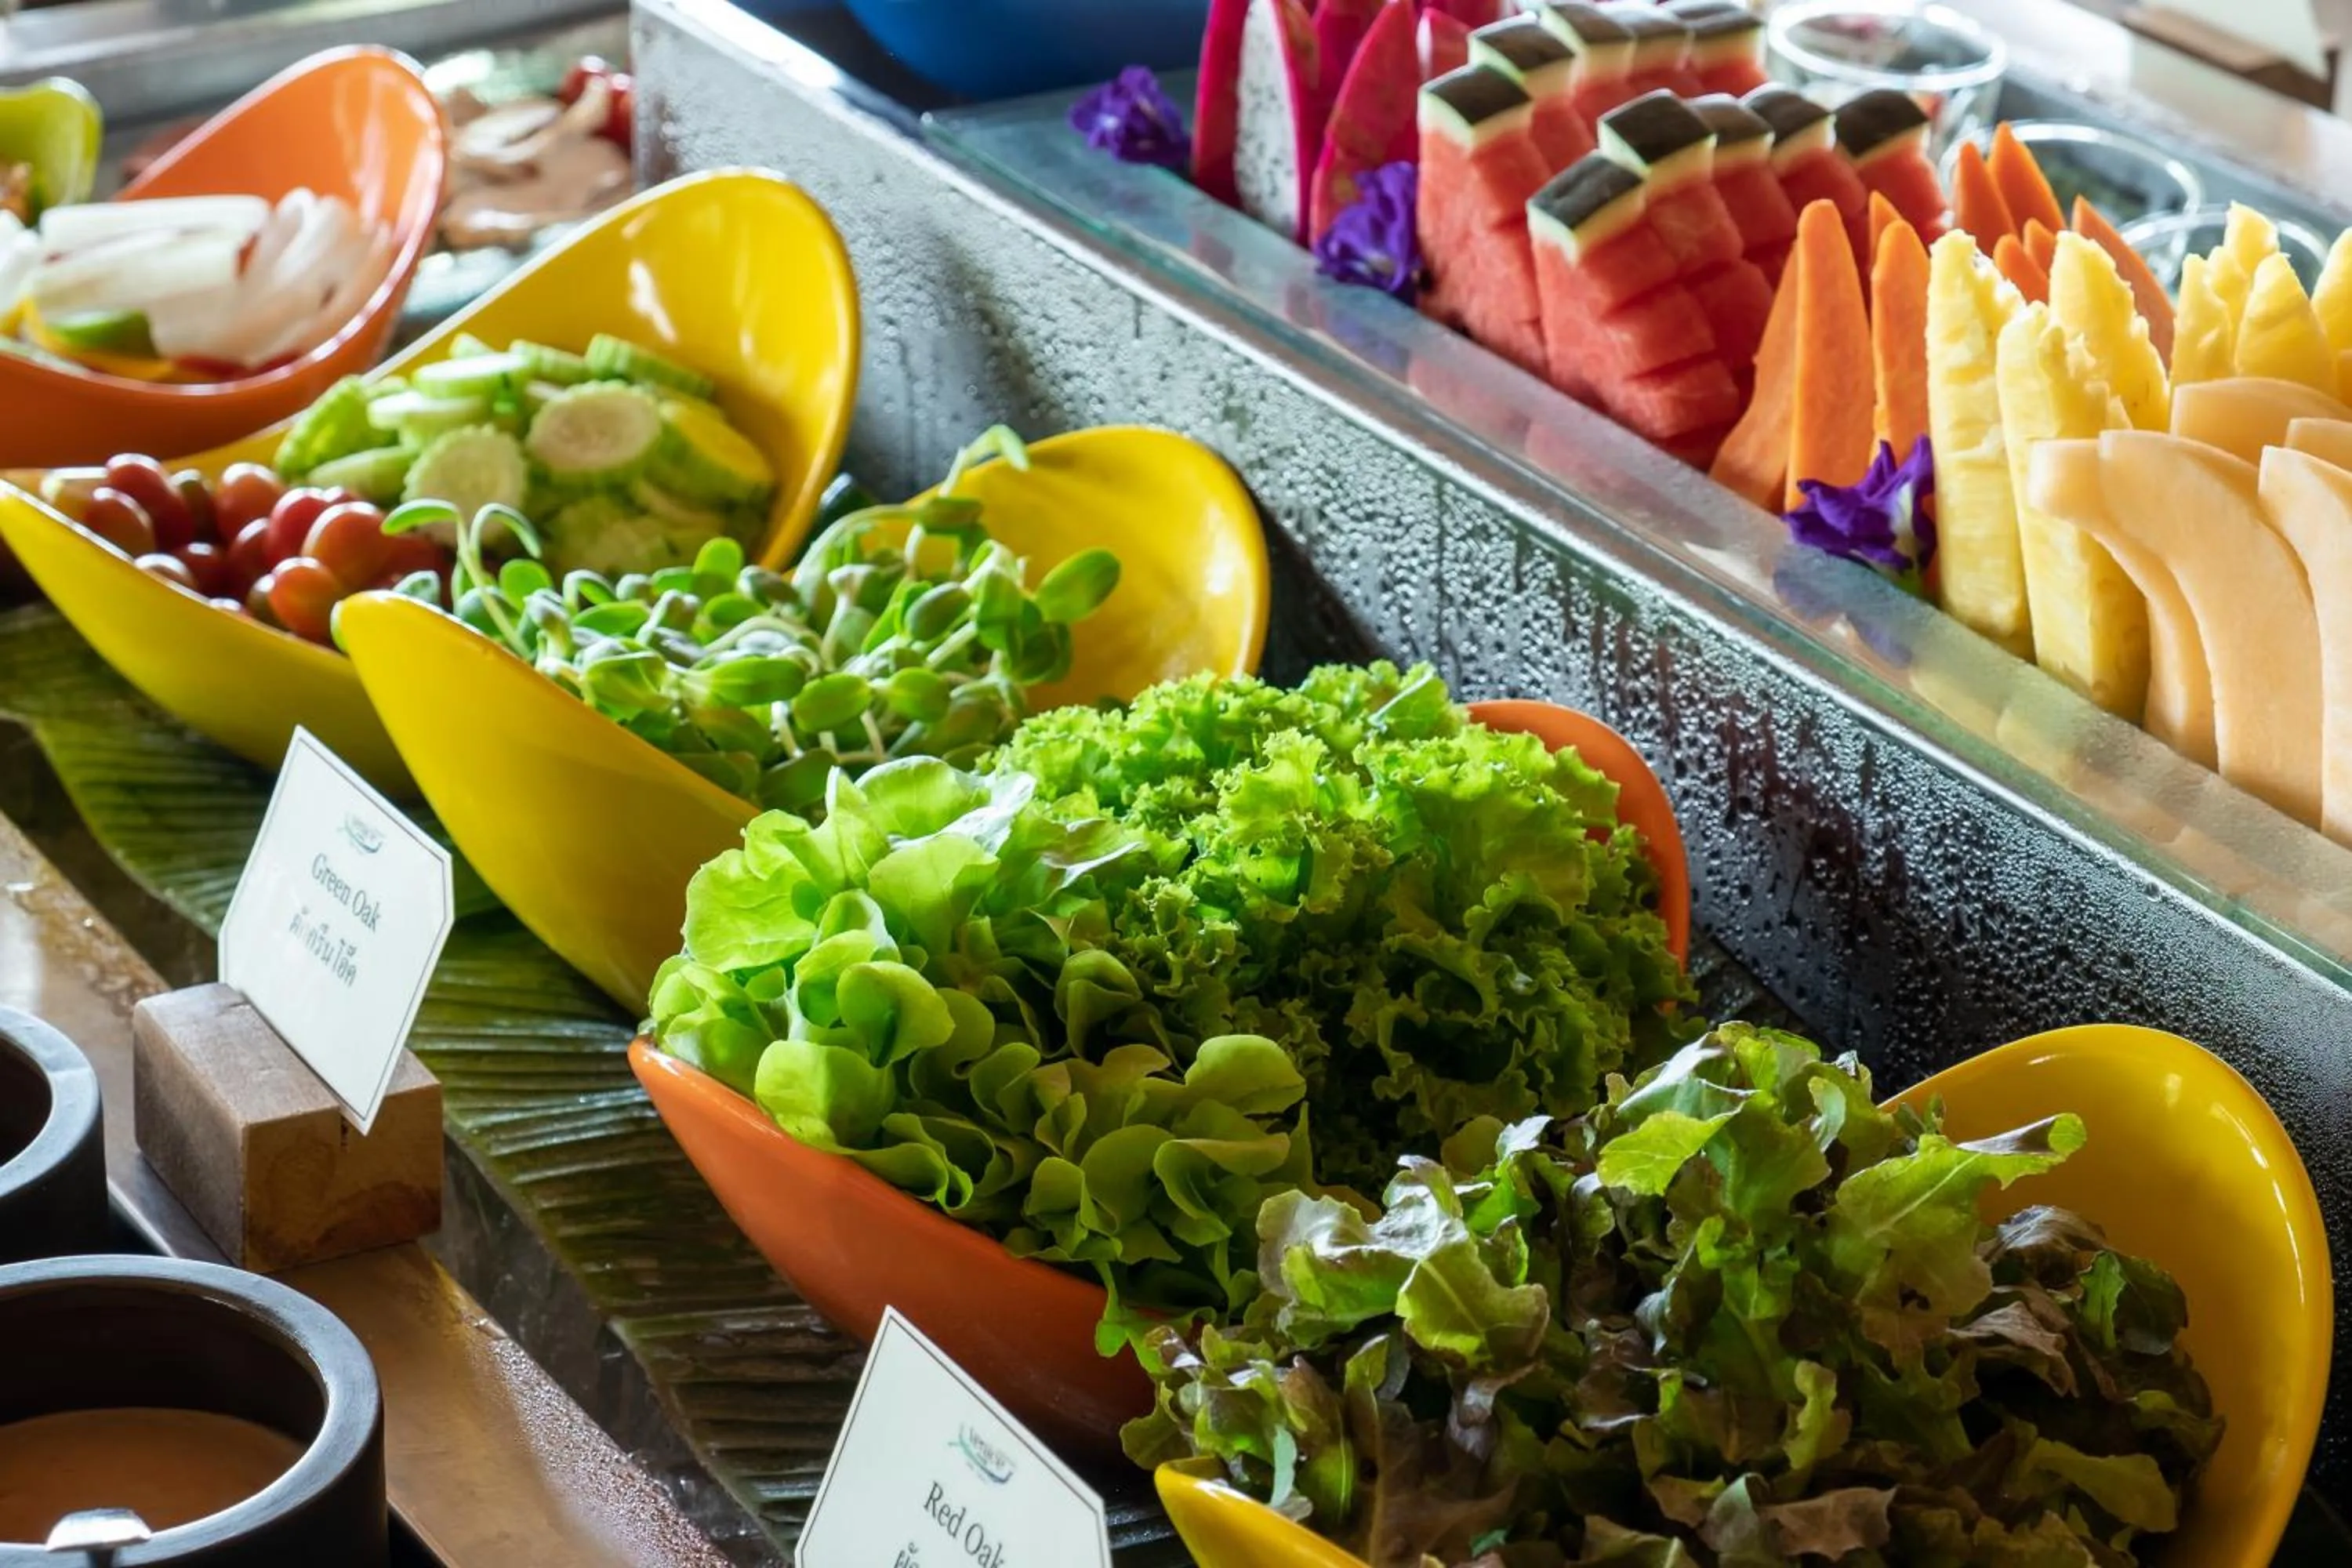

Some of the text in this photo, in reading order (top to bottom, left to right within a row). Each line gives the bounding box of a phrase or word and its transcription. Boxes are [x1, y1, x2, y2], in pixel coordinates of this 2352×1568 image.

[312, 853, 380, 934] Green Oak
[924, 1481, 967, 1538] Red
[964, 1523, 1004, 1568] Oak
